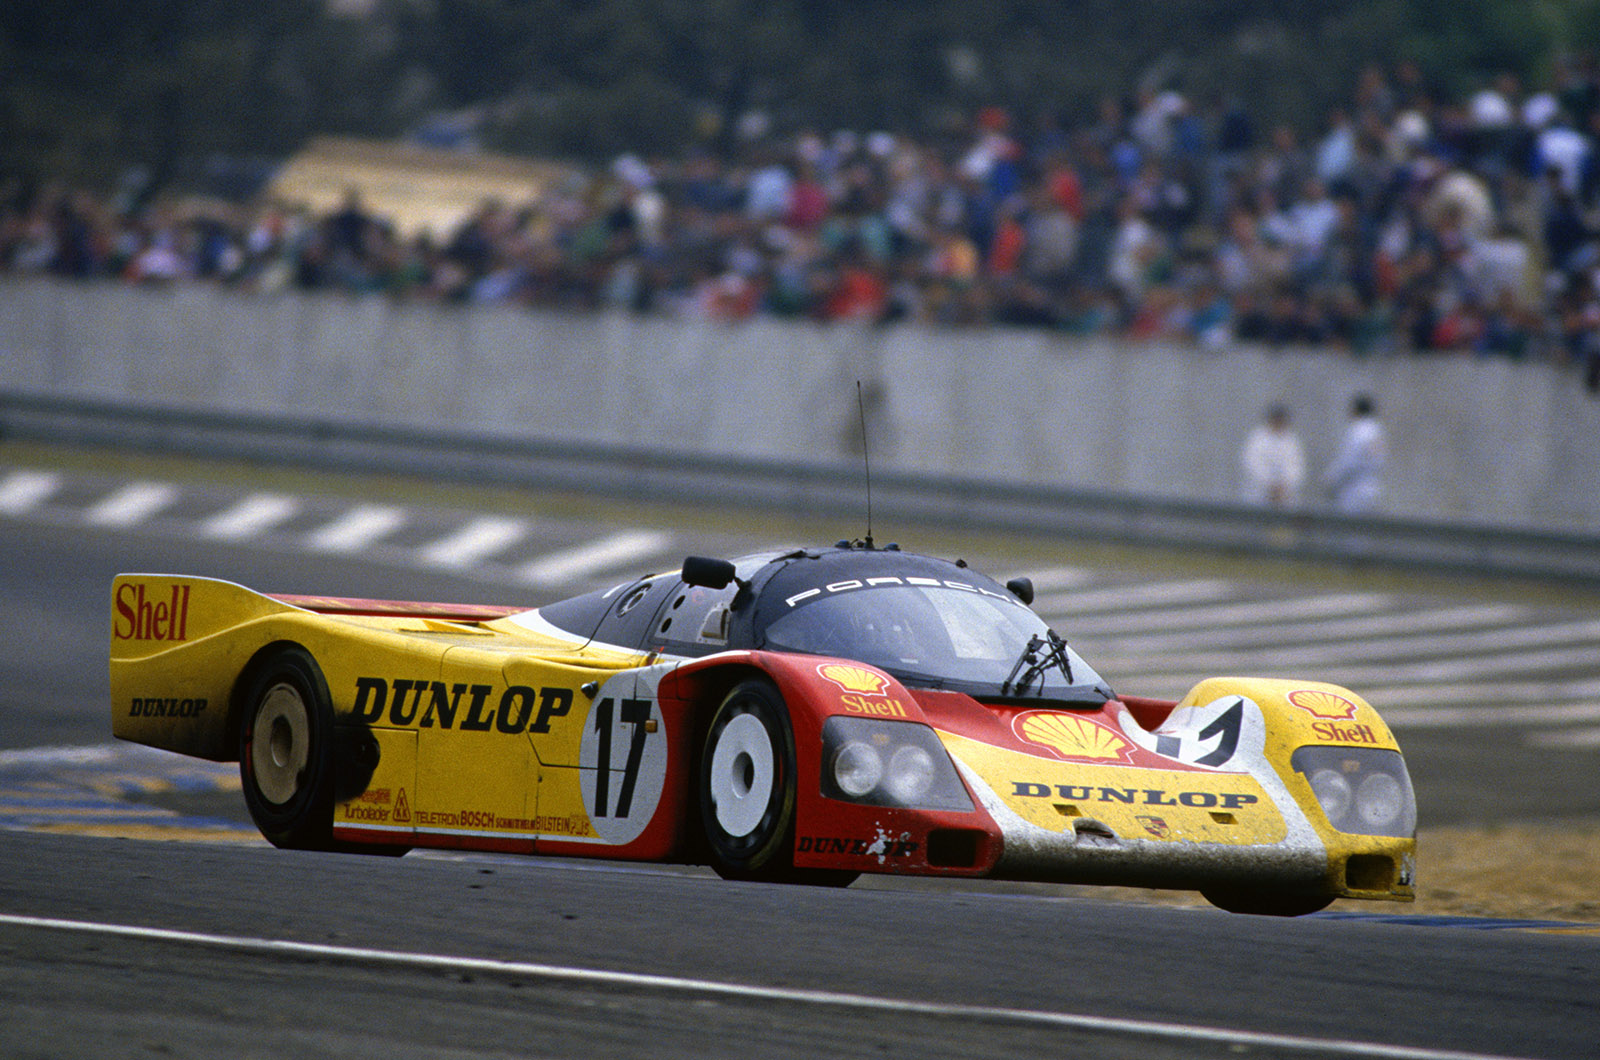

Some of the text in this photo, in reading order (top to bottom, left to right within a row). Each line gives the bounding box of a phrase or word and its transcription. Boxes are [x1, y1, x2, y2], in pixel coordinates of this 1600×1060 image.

[115, 583, 190, 641] Shell
[129, 698, 208, 717] DUNLOP
[352, 676, 574, 734] DUNLOP
[841, 695, 907, 717] Shell
[1311, 722, 1378, 743] Shell
[594, 697, 652, 818] 17
[1011, 781, 1259, 809] DUNLOP
[415, 811, 460, 825] TELETRON
[460, 810, 495, 828] BOSCH
[536, 816, 571, 832] BILSTEIN
